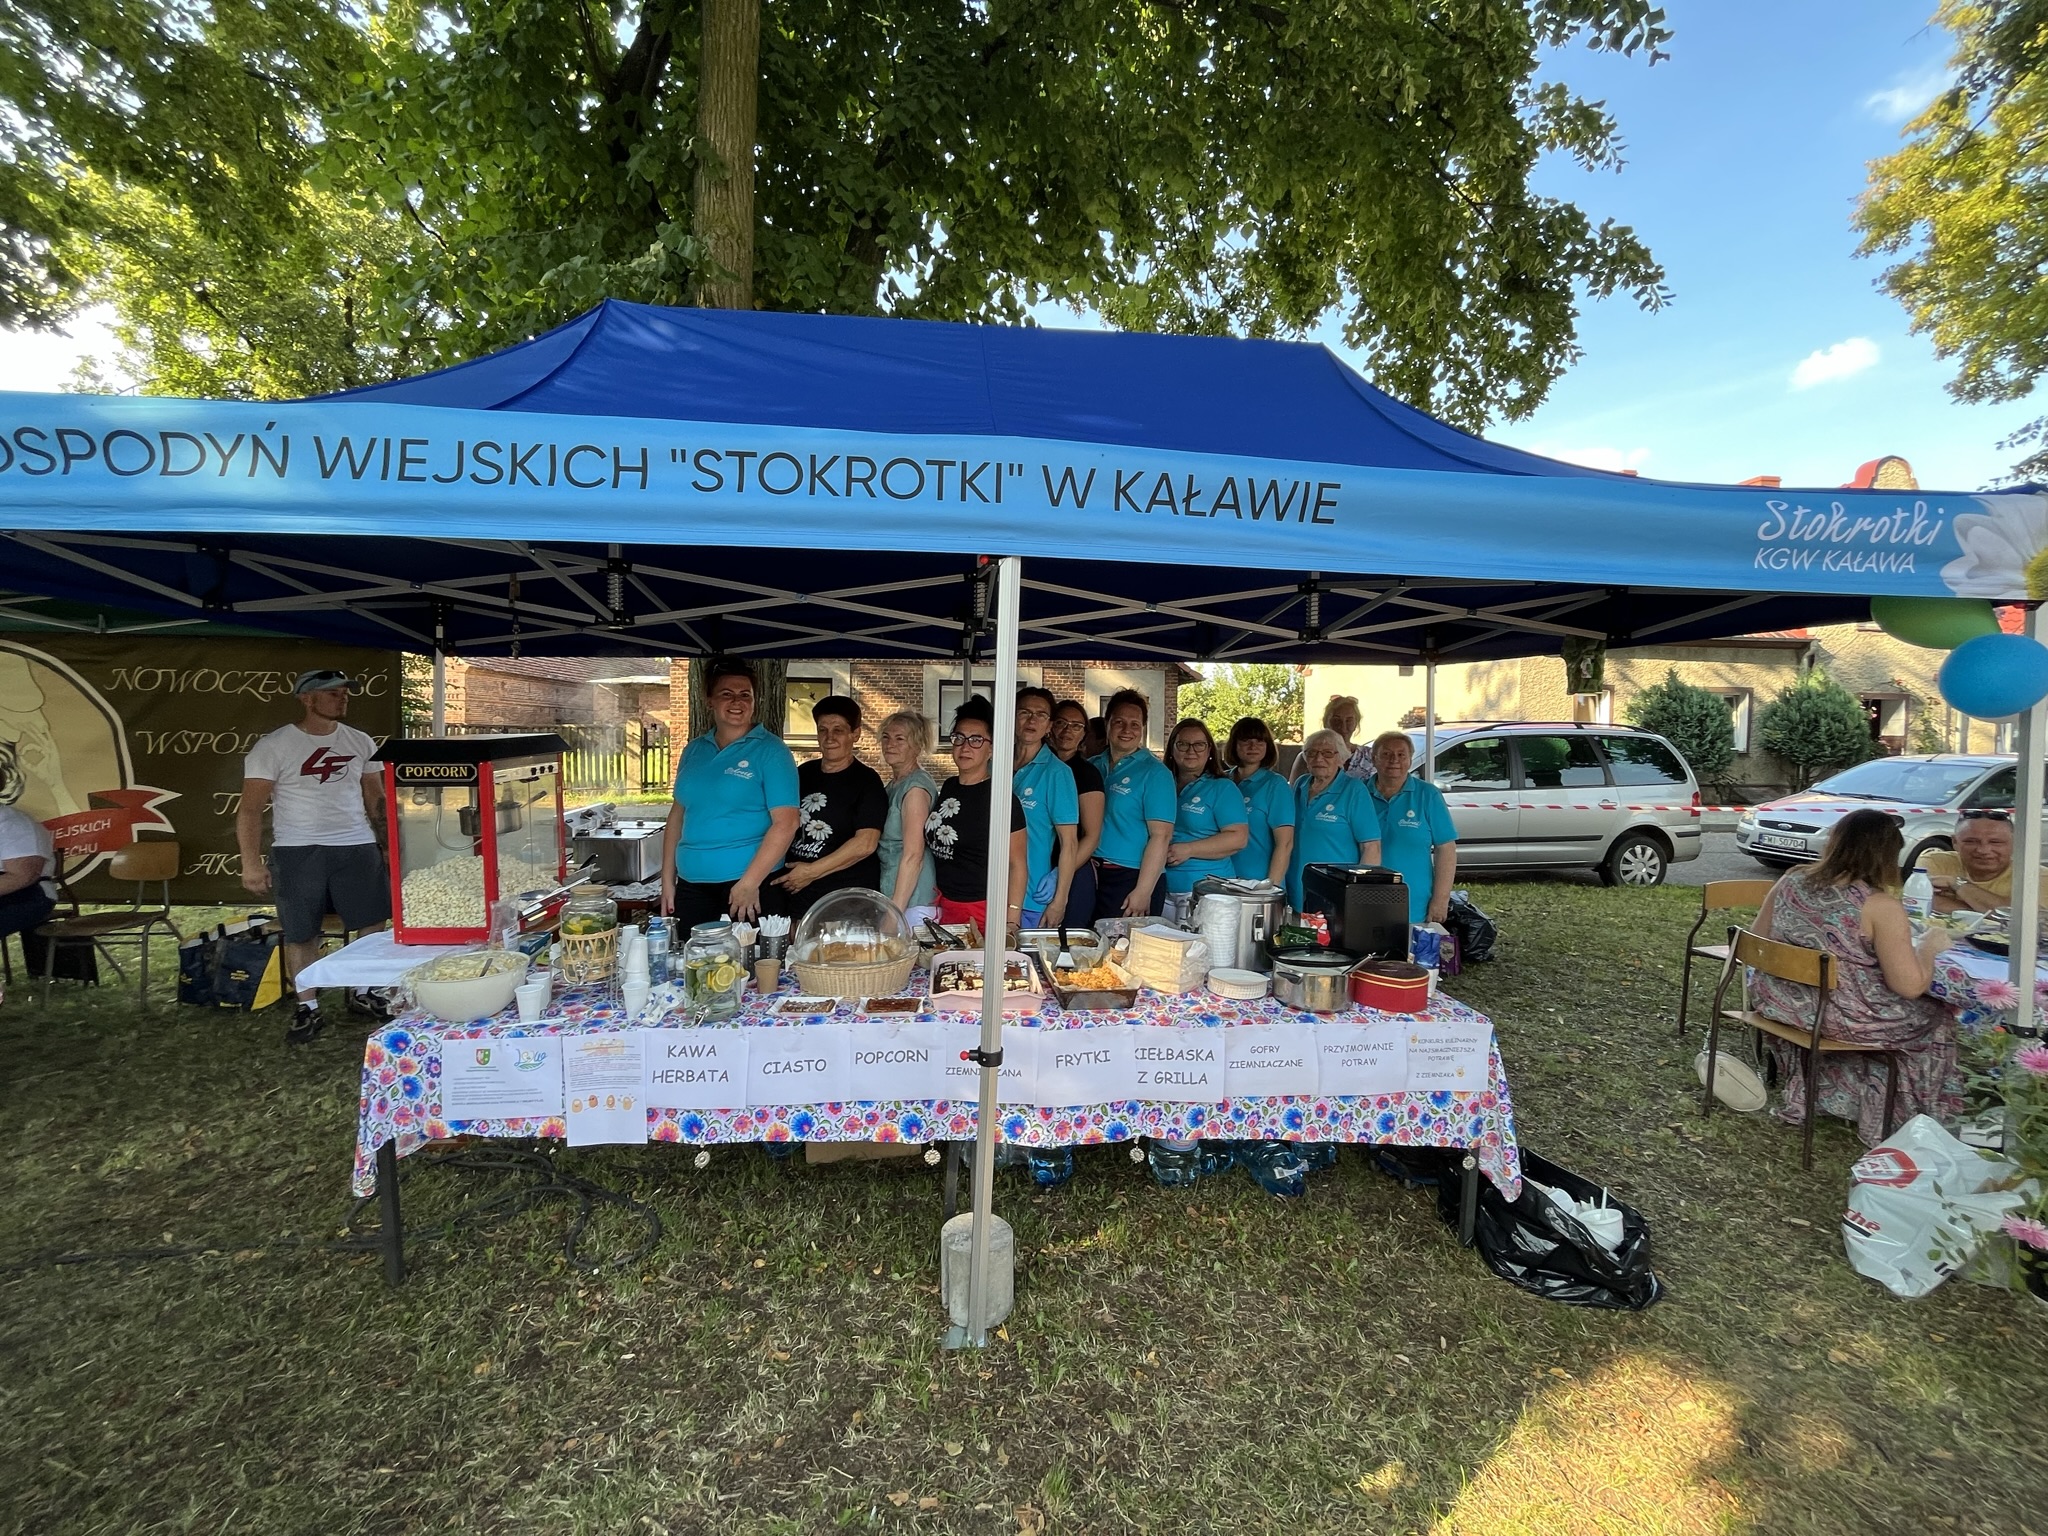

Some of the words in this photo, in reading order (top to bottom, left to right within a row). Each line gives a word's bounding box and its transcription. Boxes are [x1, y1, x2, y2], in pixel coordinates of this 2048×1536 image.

[0, 422, 290, 478] SPODYŃ
[313, 434, 650, 491] WIEJSKICH
[669, 448, 1024, 504] "STOKROTKI"
[1042, 464, 1097, 510] W
[1113, 469, 1342, 525] KAŁAWIE
[1756, 499, 1945, 546] Stokrotki
[1754, 547, 1821, 570] KGW
[1822, 550, 1916, 574] KAŁAWA
[103, 666, 388, 702] NOWOCZESŚĆ
[405, 766, 468, 778] POPCORN
[667, 1044, 717, 1058] KAWA
[1250, 1045, 1281, 1054] GOFRY
[1323, 1042, 1395, 1054] PRZYJMOWANIE
[854, 1049, 930, 1065] POPCORN
[1055, 1049, 1111, 1069] FRYTKI
[1228, 1058, 1304, 1069] ZIEMNIACZANE
[1341, 1057, 1378, 1067] POTRAW
[762, 1058, 827, 1075] CIASTO
[651, 1069, 729, 1084] HERBATA
[1137, 1071, 1148, 1084] Z
[1154, 1070, 1208, 1085] GRILLA
